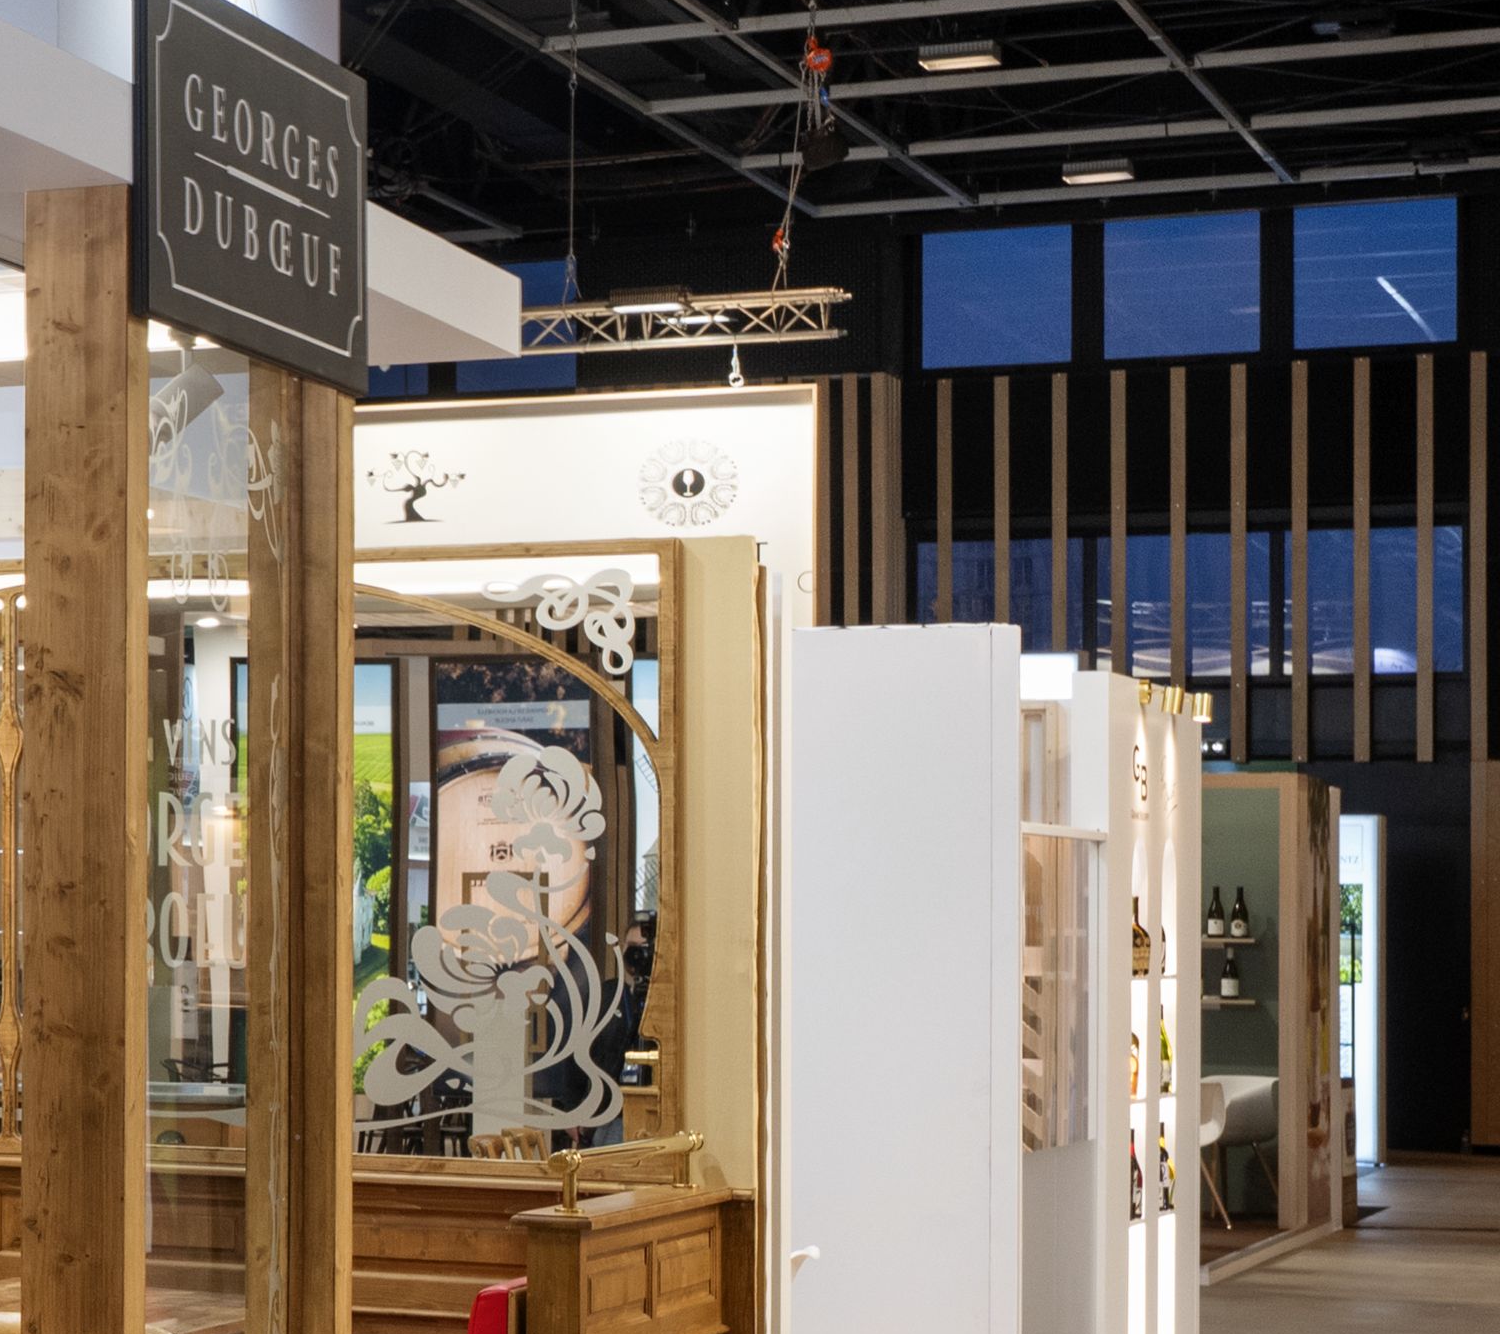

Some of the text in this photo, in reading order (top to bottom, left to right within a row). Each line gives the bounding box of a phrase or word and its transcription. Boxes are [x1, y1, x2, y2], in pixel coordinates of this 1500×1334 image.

[183, 72, 340, 200] GEORGES
[183, 177, 343, 297] DUBŒUF
[163, 718, 236, 767] VINS
